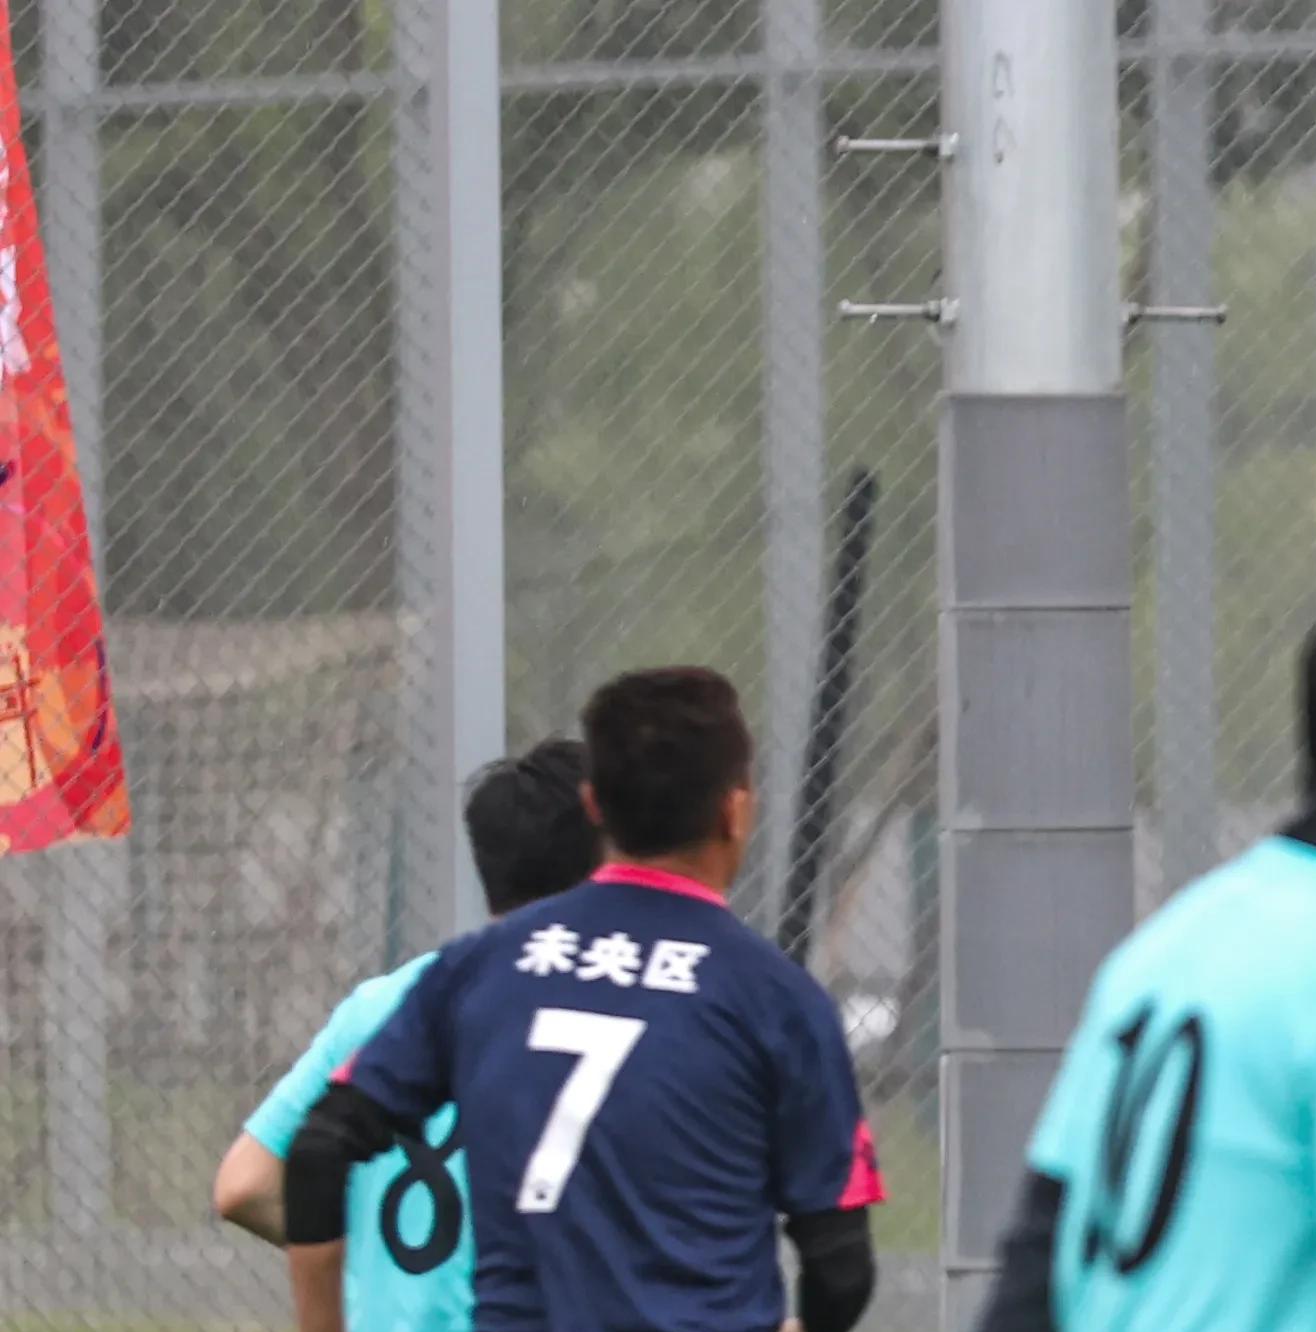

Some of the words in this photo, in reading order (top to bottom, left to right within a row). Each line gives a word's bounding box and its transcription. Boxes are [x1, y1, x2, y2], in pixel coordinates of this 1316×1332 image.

[515, 923, 711, 993] 未央区
[516, 1007, 648, 1214] 7
[1082, 998, 1203, 1275] 10
